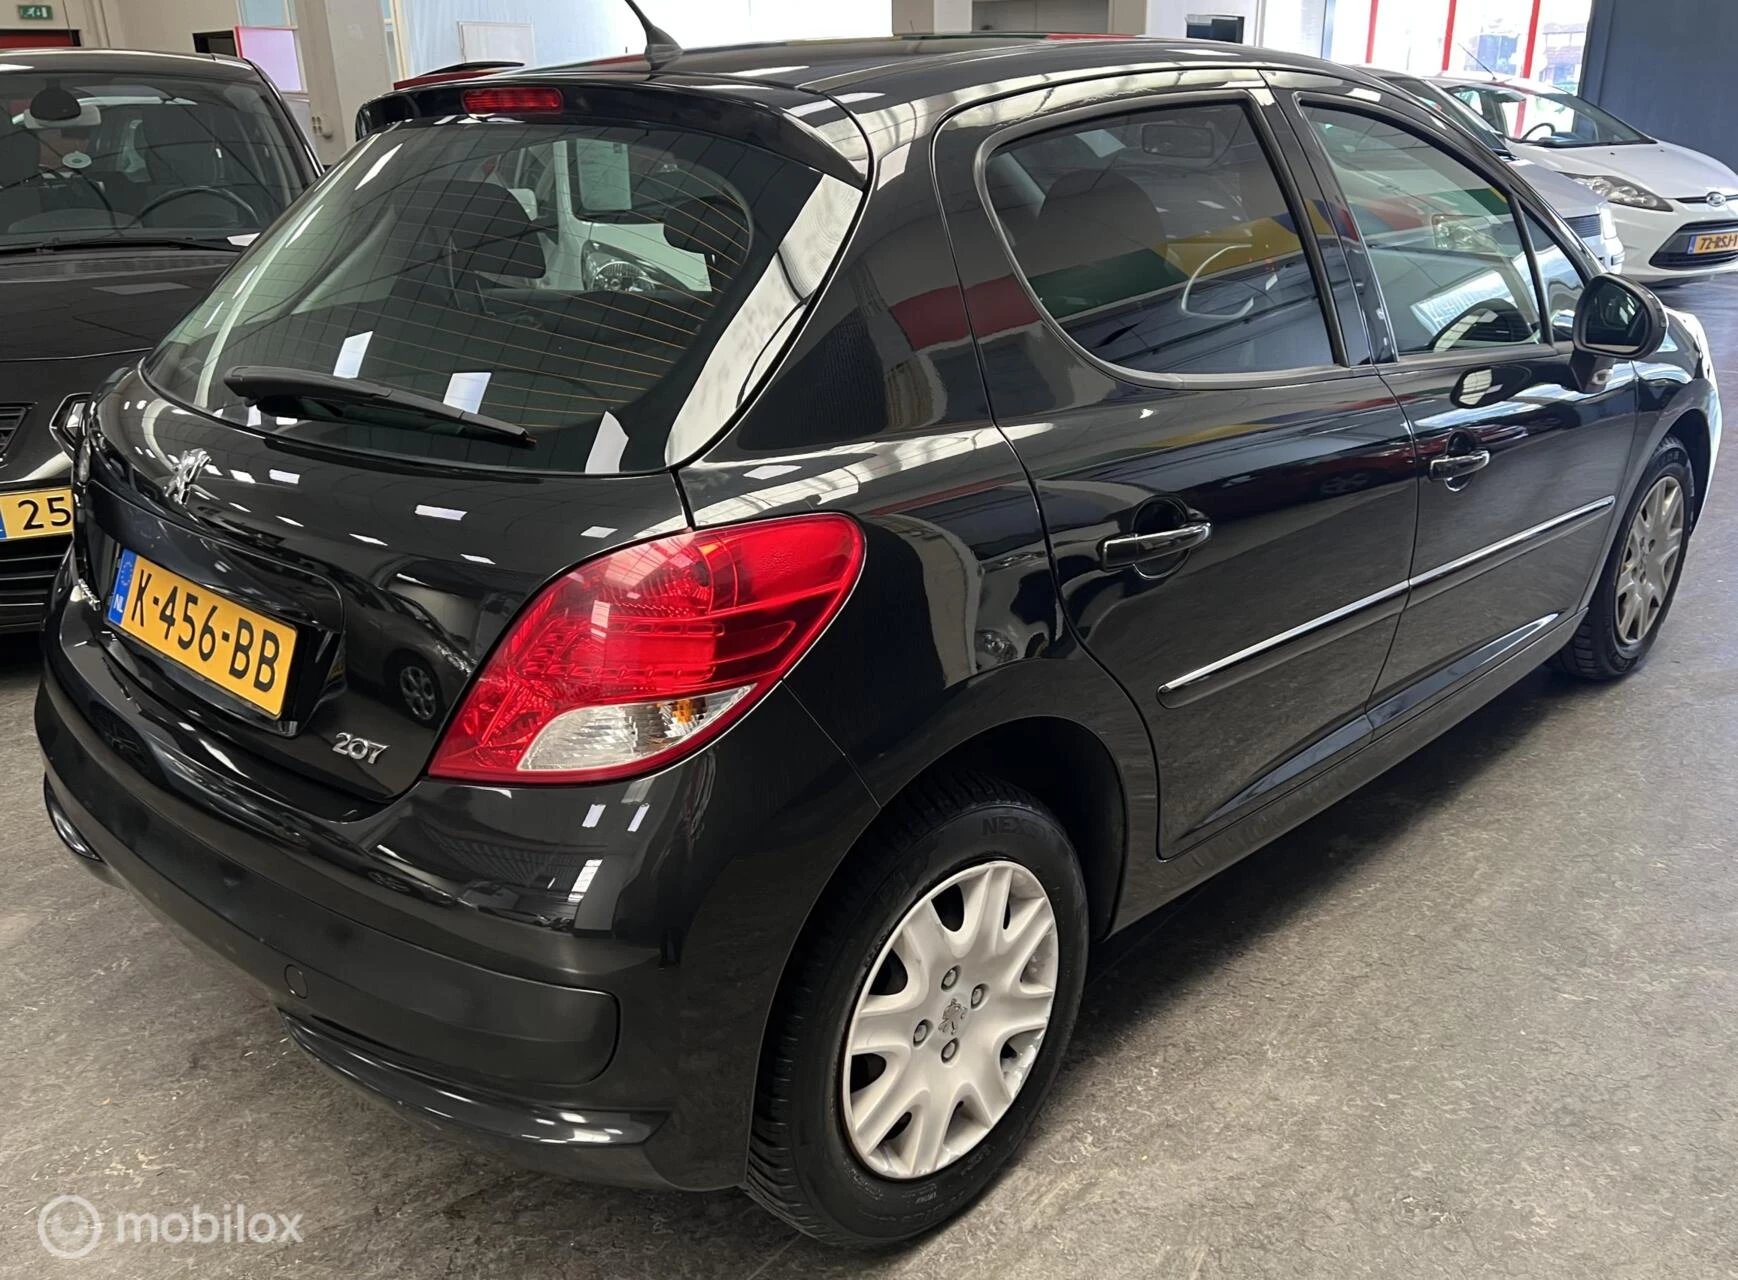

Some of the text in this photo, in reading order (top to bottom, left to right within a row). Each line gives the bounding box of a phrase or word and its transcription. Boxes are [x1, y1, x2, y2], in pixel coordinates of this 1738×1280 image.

[17, 496, 72, 531] 25
[130, 568, 281, 693] K-456-BB
[332, 732, 390, 765] 207
